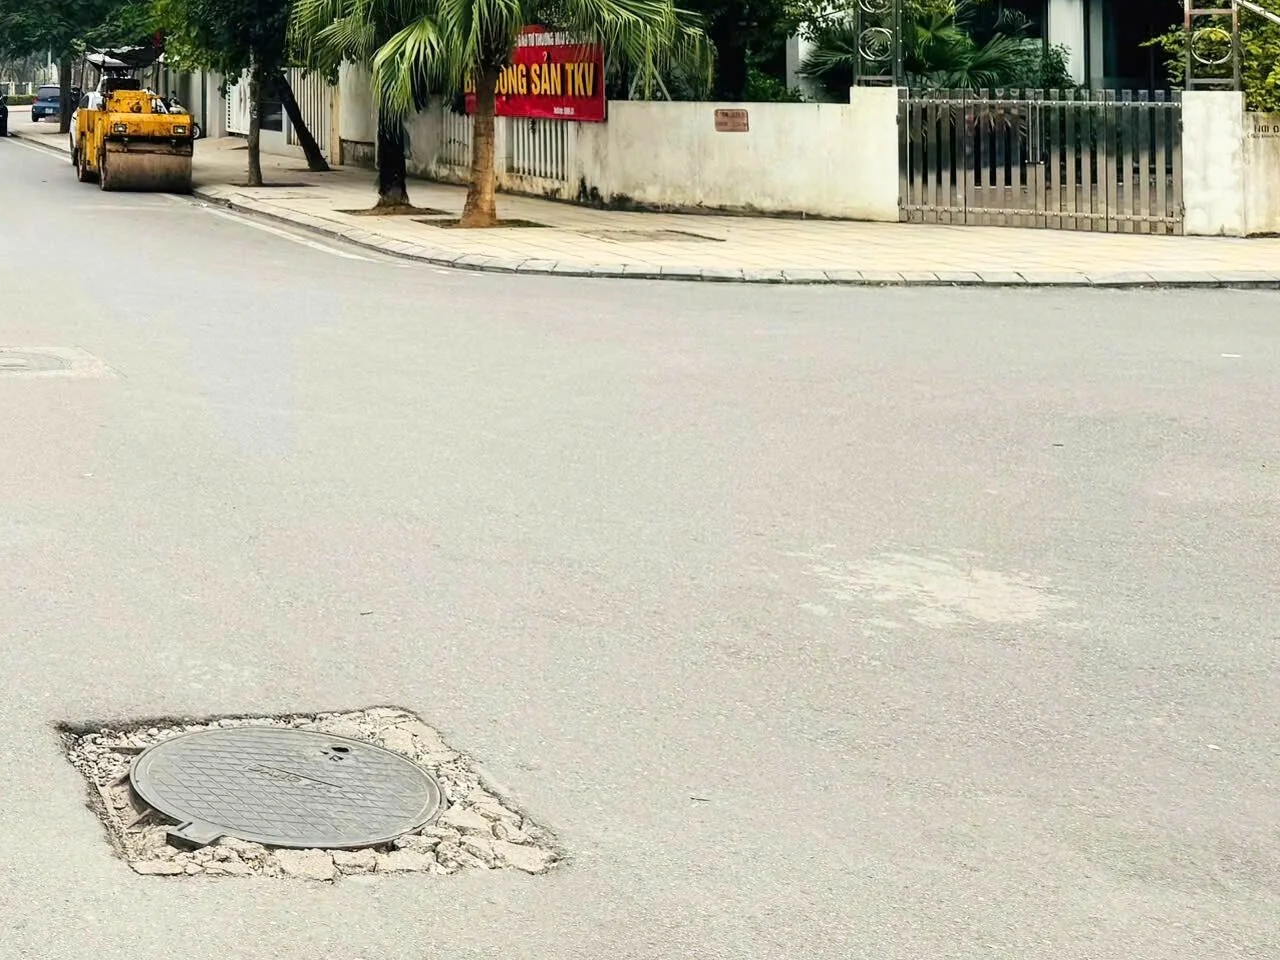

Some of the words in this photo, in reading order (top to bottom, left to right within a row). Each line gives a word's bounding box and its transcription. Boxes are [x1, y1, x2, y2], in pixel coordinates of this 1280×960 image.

[494, 64, 527, 101] ỘNG
[531, 50, 562, 96] SẢN
[565, 62, 594, 97] TKV
